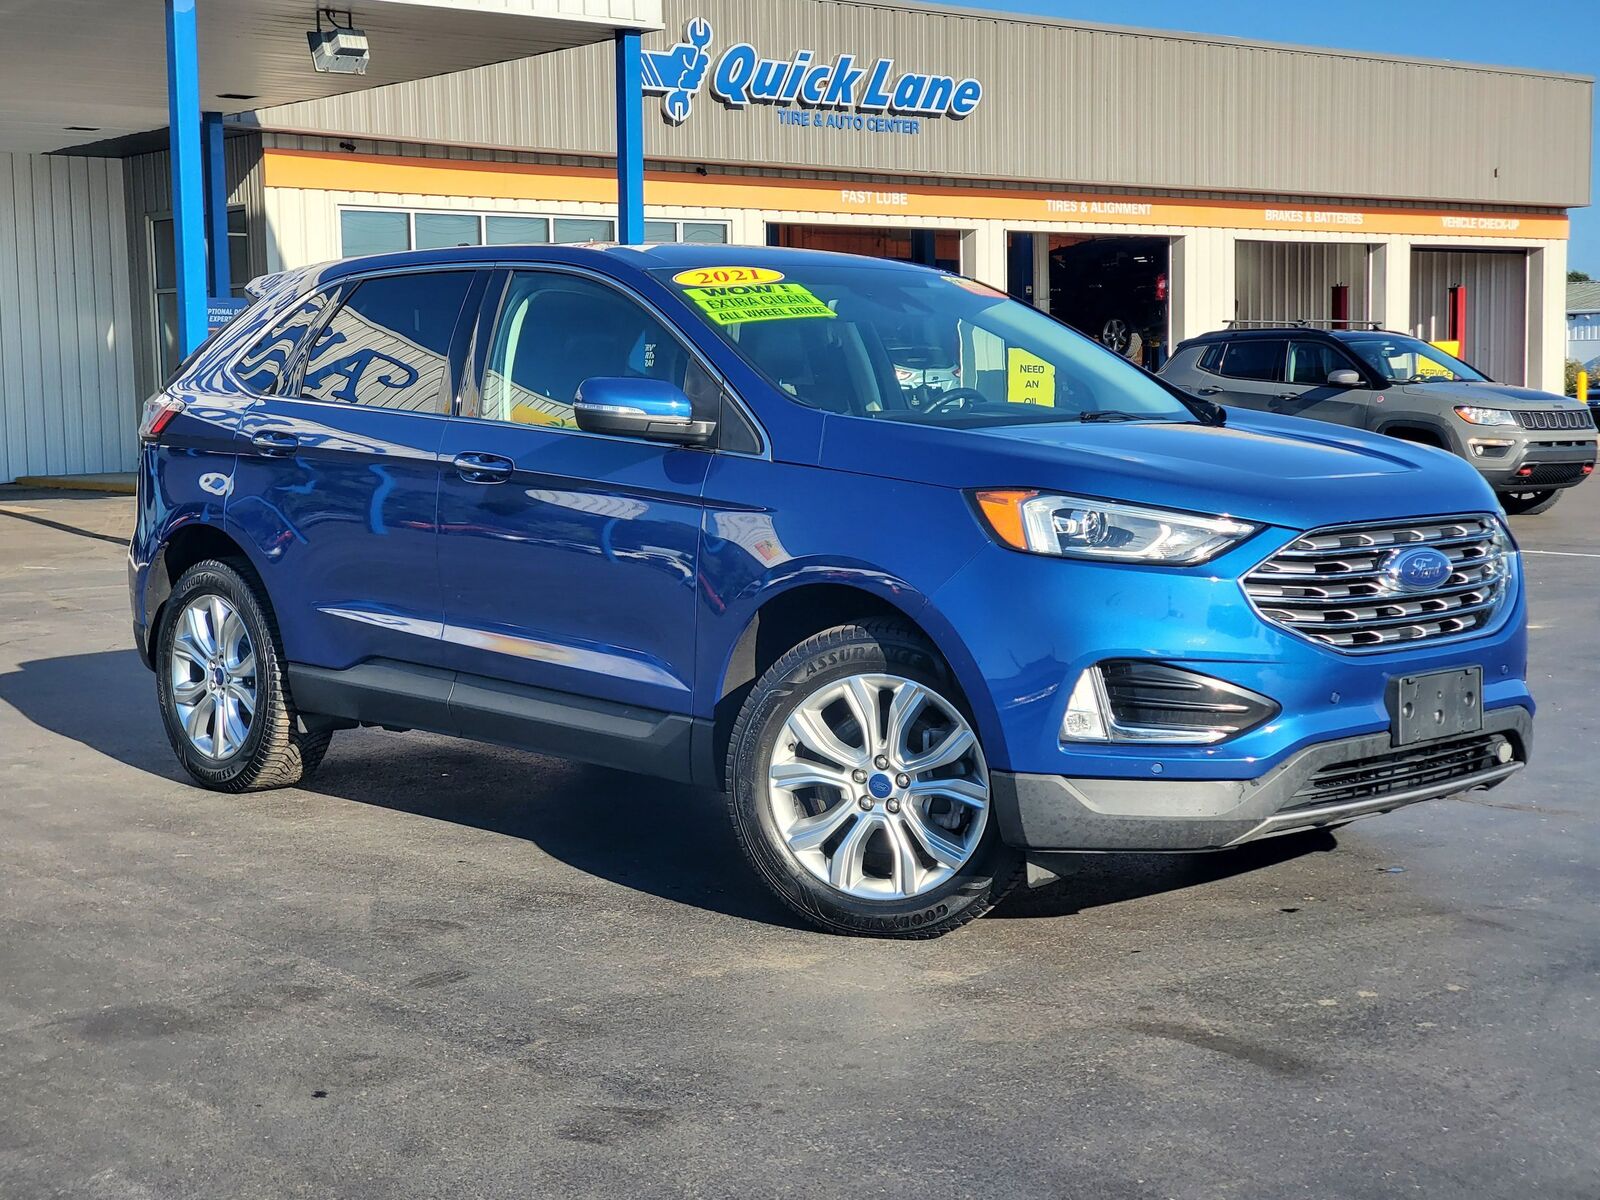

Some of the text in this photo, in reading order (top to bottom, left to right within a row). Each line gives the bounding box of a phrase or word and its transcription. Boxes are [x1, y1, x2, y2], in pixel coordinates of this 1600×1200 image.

[713, 43, 983, 116] Quick Lane
[777, 109, 920, 135] TIRE & AUTO CENTER
[841, 190, 908, 206] FAST LUBE
[1046, 199, 1152, 216] TIRES & ALIGNMENT
[1265, 209, 1364, 225] BRAKES & BATTERIES
[1441, 216, 1477, 230] VEHICLE
[695, 269, 761, 284] 2021
[700, 284, 772, 297] WOW
[706, 294, 810, 310] EXTRA CLEAN
[718, 306, 827, 322] ALL WHEEL DRIVE
[1019, 364, 1045, 374] NEED
[1025, 380, 1039, 388] AN
[806, 645, 923, 678] ASSURANCE
